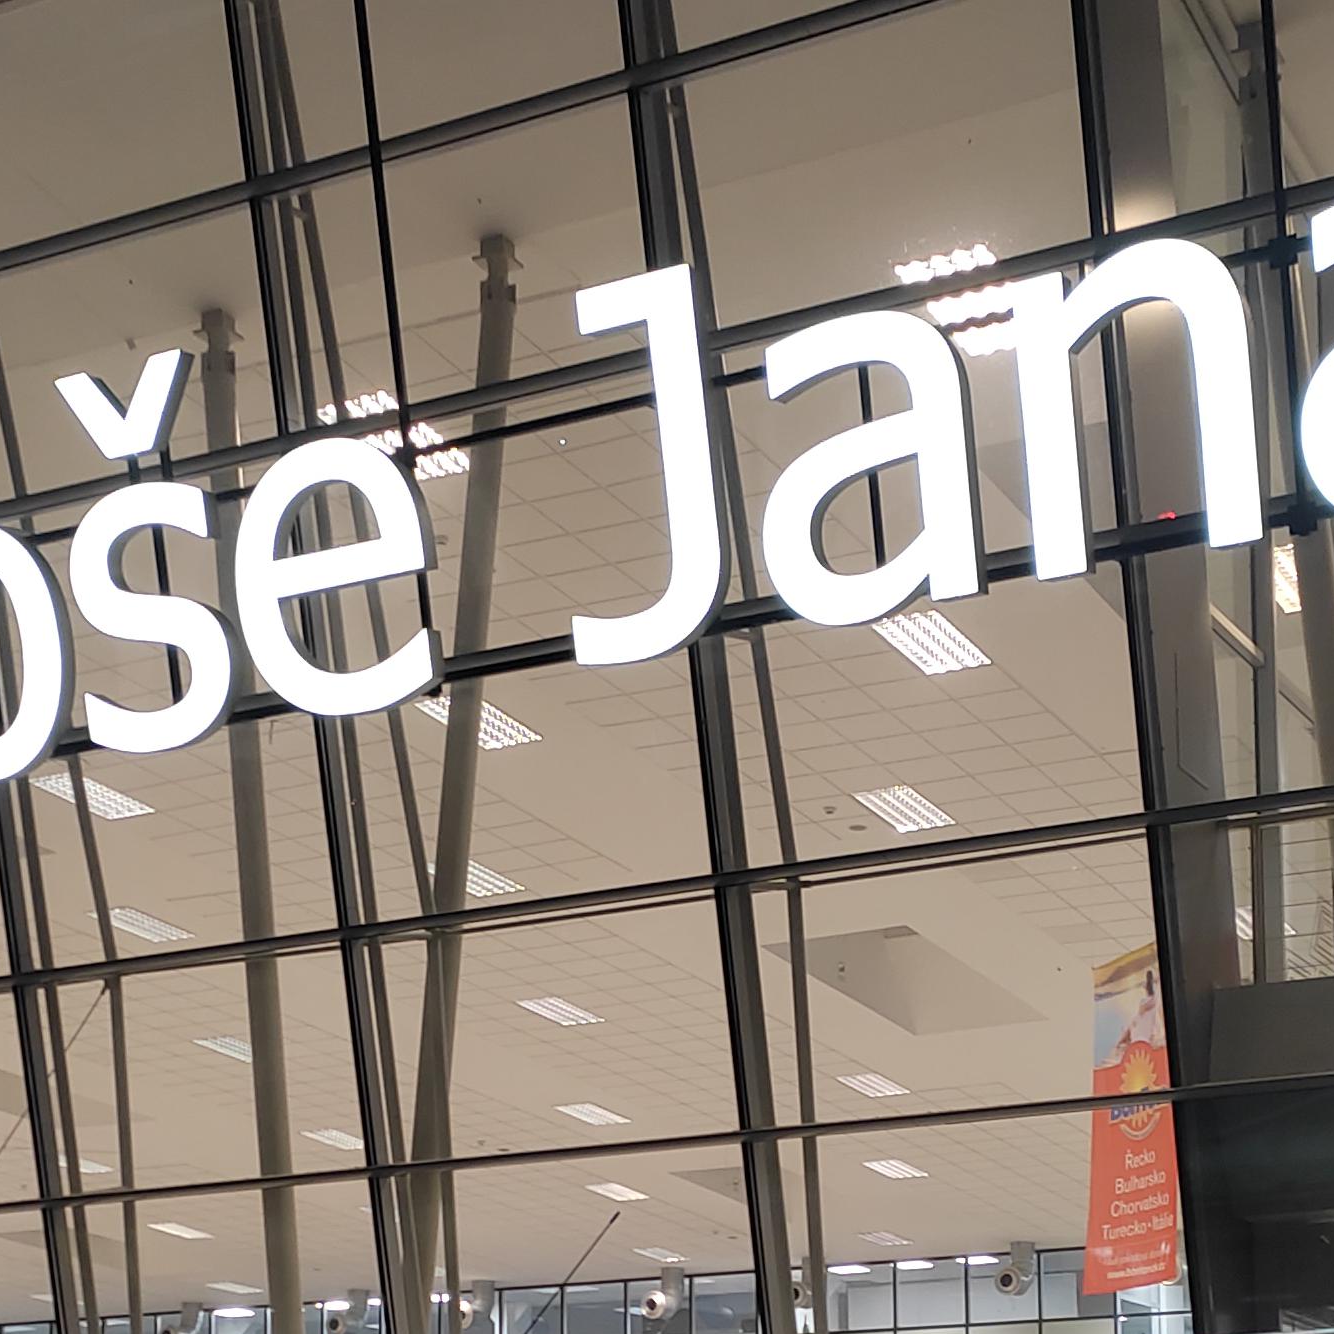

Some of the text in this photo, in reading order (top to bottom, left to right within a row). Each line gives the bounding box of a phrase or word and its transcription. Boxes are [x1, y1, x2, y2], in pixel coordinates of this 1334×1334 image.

[1124, 1148, 1156, 1170] Řecko
[1115, 1169, 1167, 1195] Bulharsko
[1110, 1191, 1170, 1218] Chorvatsko
[1101, 1220, 1147, 1240] Turecko
